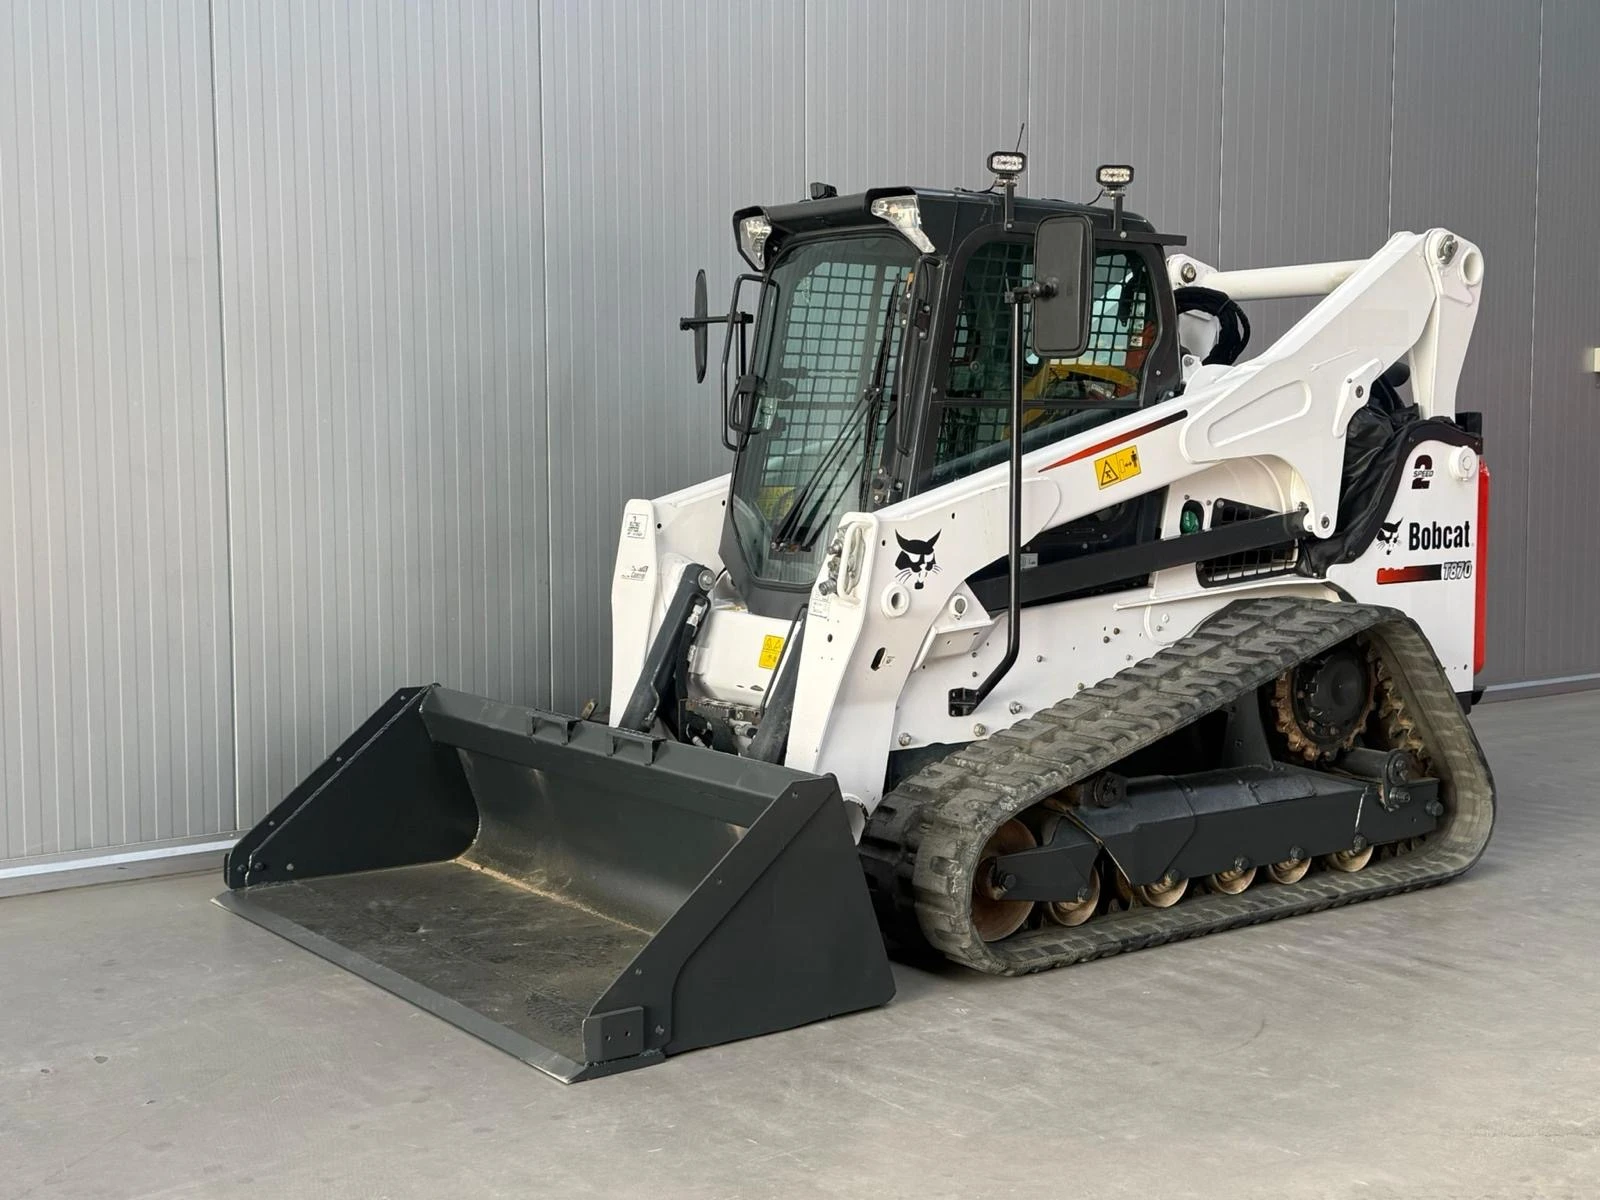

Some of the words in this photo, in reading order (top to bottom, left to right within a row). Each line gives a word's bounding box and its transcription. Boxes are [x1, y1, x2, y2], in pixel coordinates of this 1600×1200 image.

[1411, 454, 1433, 489] 2
[1413, 469, 1434, 478] SPEED
[1409, 521, 1470, 550] Bobcat
[1443, 561, 1473, 580] T870
